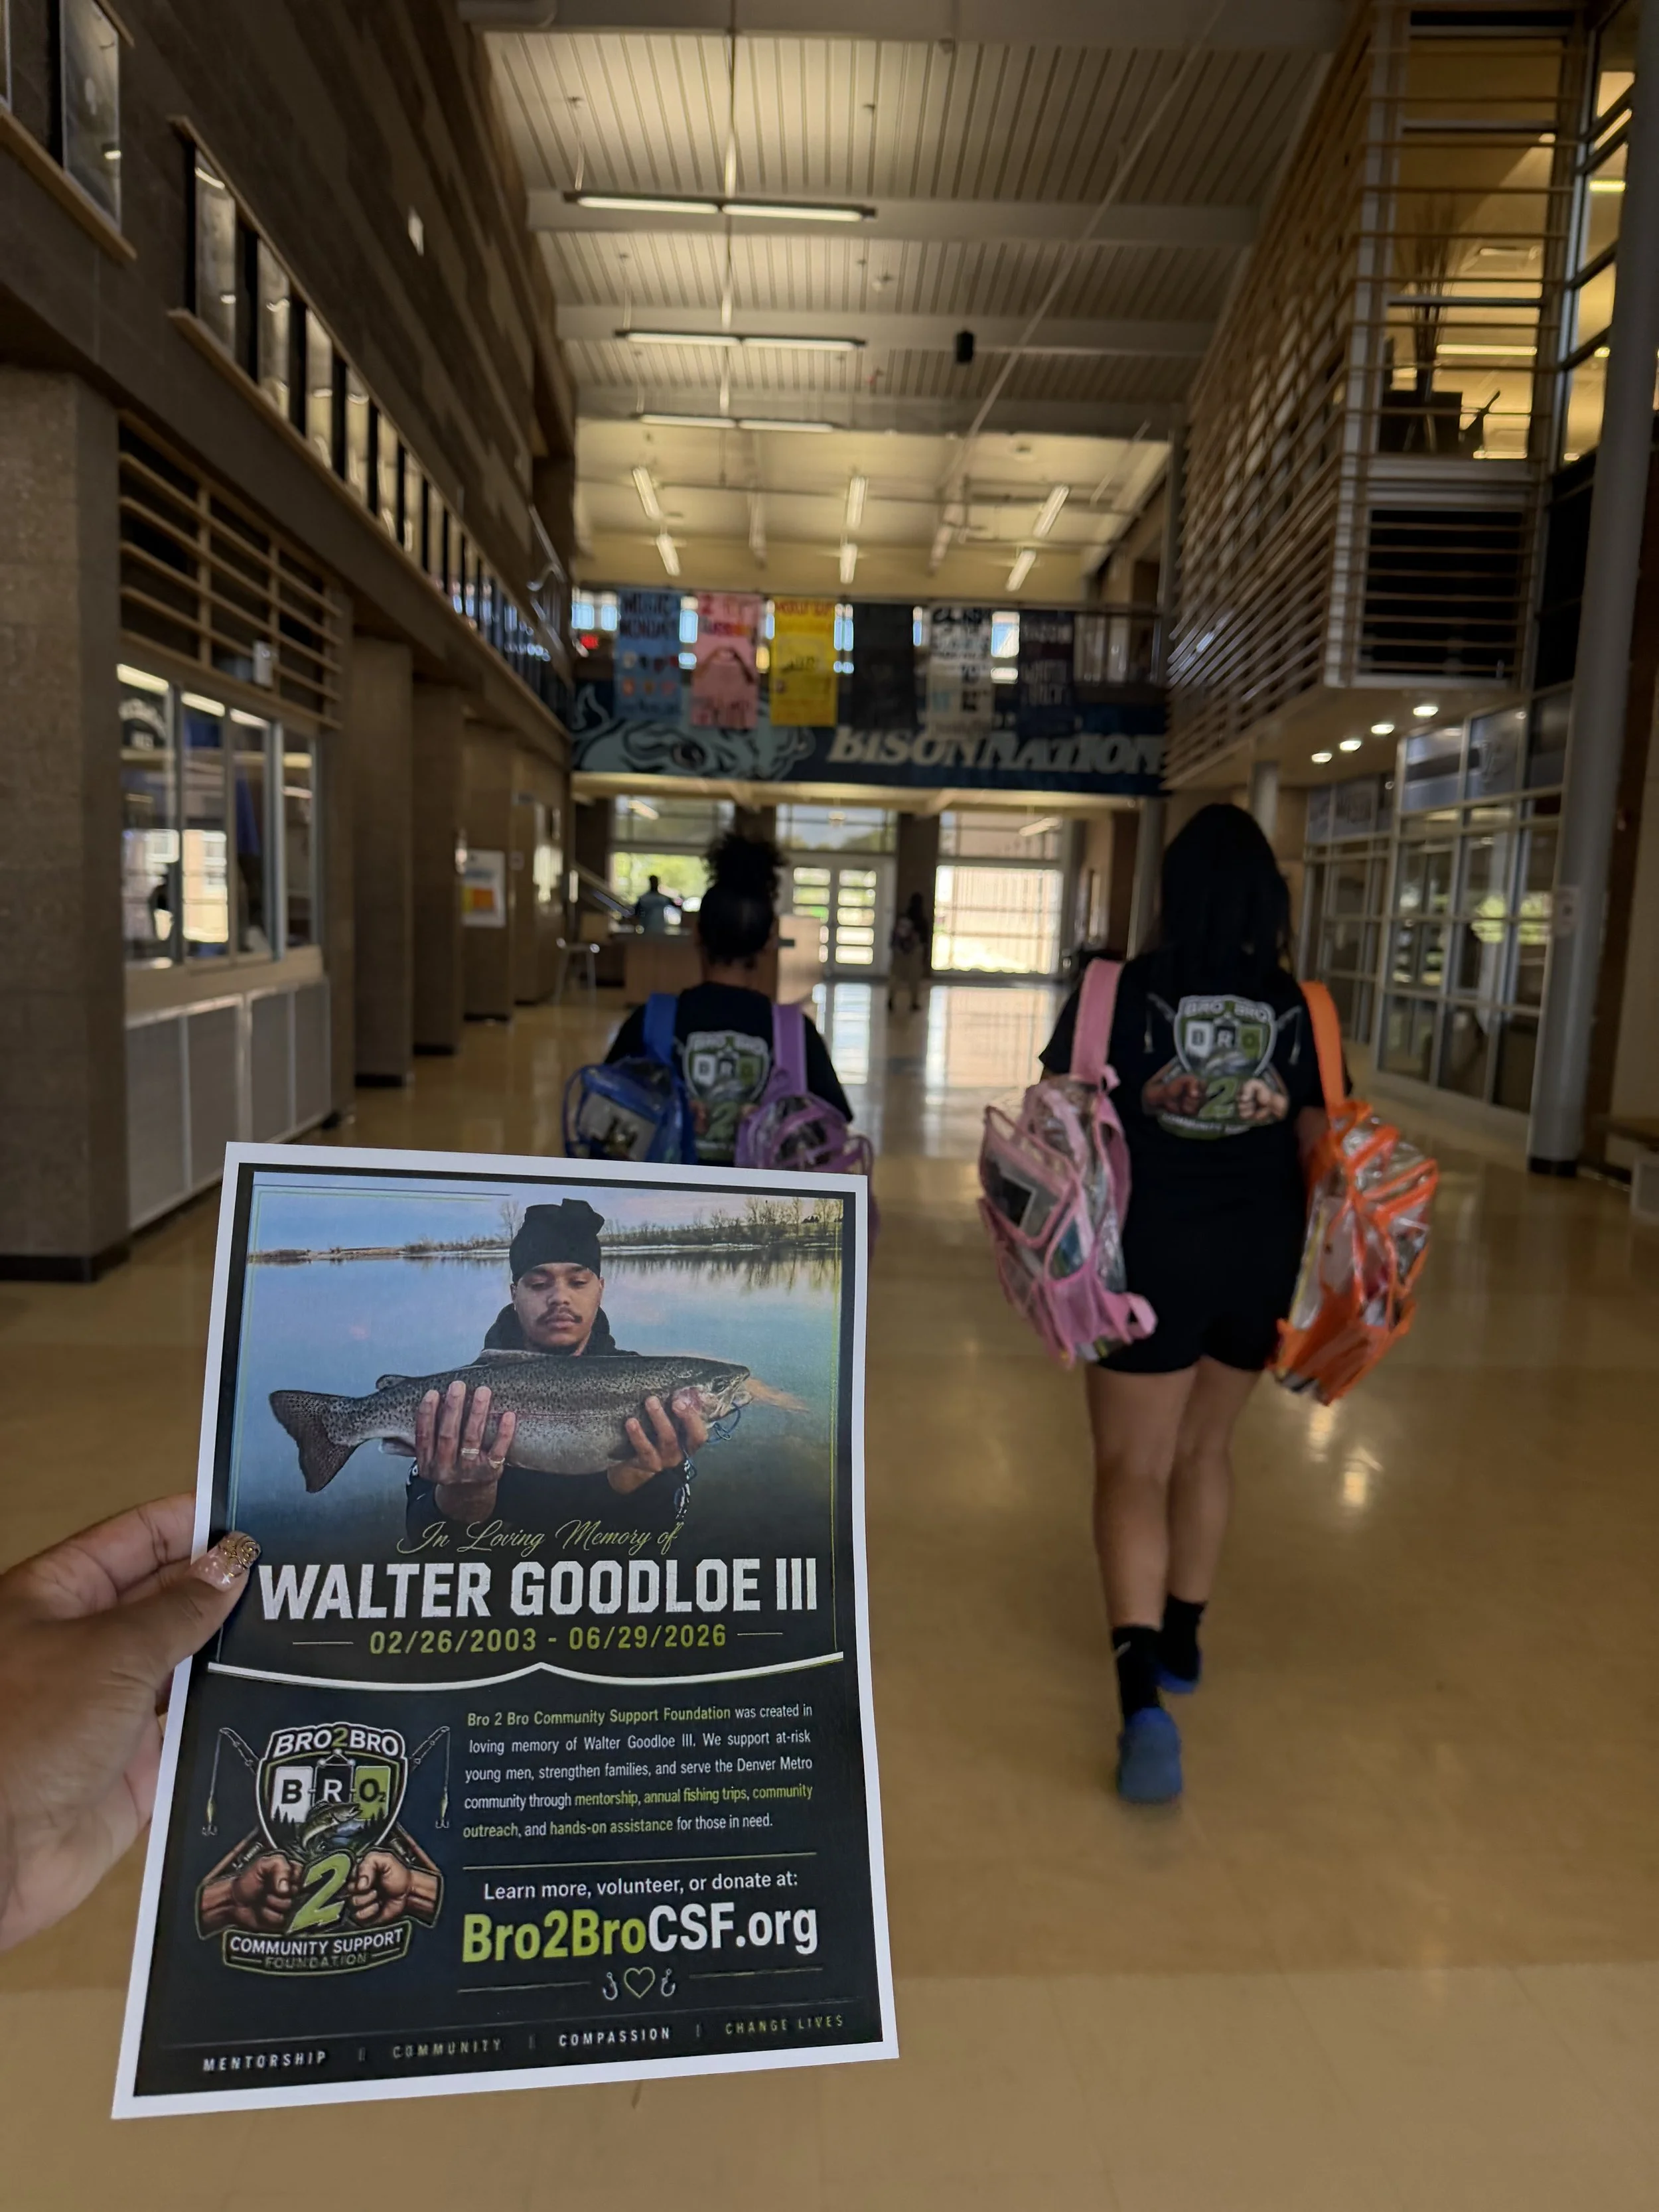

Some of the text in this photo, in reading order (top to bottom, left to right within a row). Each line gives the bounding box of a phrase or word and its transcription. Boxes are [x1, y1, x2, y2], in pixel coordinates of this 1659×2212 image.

[827, 727, 983, 768] BISON
[1198, 1076, 1238, 1120] 2
[396, 1519, 680, 1558] In Loving Memory of
[257, 1558, 818, 1620] WALTER GOODLOE III
[370, 1627, 536, 1655] 02/26/2003
[569, 1623, 726, 1650] 06/29/2026
[467, 1703, 813, 1726] Bro 2 Bro Community Support Foundation was created in
[273, 1727, 399, 1758] BRO2BRO
[469, 1729, 811, 1756] loving memory of Walter Goodloe III. We support at-risk
[465, 1756, 813, 1784] young men, strengthen families, and serve the Denver Metro
[464, 1783, 813, 1812] community through mentorship, annual fishing trips, community
[463, 1812, 773, 1838] outreach, and hands-on assistance for those in need.
[289, 1852, 351, 1933] 2
[484, 1870, 798, 1900] Learn more, volunteer, or donate at:
[230, 1928, 403, 1956] COMMUNITY SUPPORT
[462, 1901, 818, 1962] Bro2BroCSF.org
[264, 1953, 367, 1969] FOUNDATION
[559, 2027, 670, 2047] COMPASSION
[725, 2014, 843, 2035] CHANGE LIVES
[202, 2050, 326, 2072] MENTORSHIP
[392, 2038, 500, 2059] COMMUNITY
